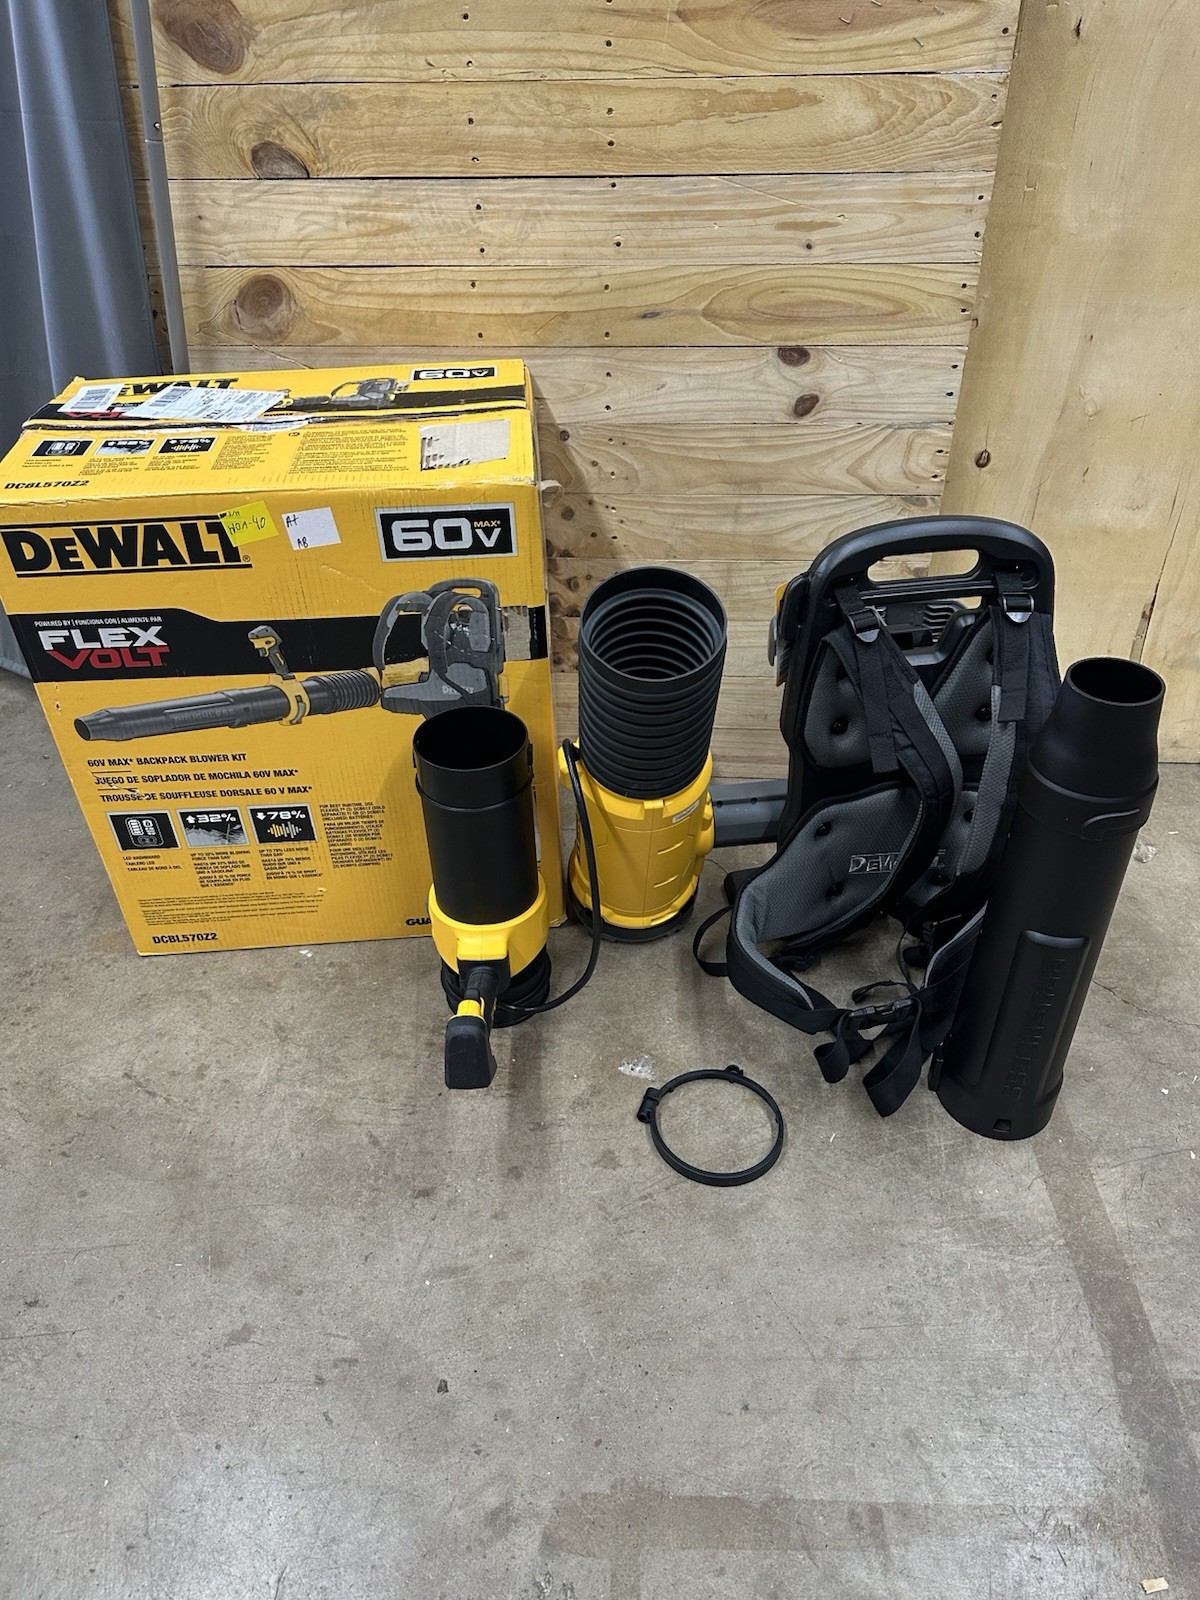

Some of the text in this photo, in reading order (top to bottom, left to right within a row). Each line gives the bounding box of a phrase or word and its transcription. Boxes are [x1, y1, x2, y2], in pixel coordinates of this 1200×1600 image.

[75, 618, 104, 626] FUNCIONA
[38, 626, 168, 650] FLEX
[46, 646, 170, 669] VOLT
[87, 759, 105, 767] 60V
[136, 755, 187, 765] BACKPACK
[189, 753, 229, 763] BLOWER
[231, 753, 246, 761] KIT
[95, 776, 124, 785] JUEGO
[127, 775, 139, 784] DE
[142, 773, 191, 783] SOPLADOR
[193, 773, 206, 781] DE
[208, 770, 251, 780] MOCHILA
[253, 770, 270, 778] 60V
[100, 793, 142, 802] TROUSSE
[160, 790, 217, 800] SOUFFLEUSE
[220, 788, 262, 798] DORSALE
[264, 787, 276, 795] 60
[278, 786, 284, 795] V
[196, 813, 236, 823] 32%
[267, 810, 306, 820] 78%
[153, 932, 218, 944] DCBL570Z2
